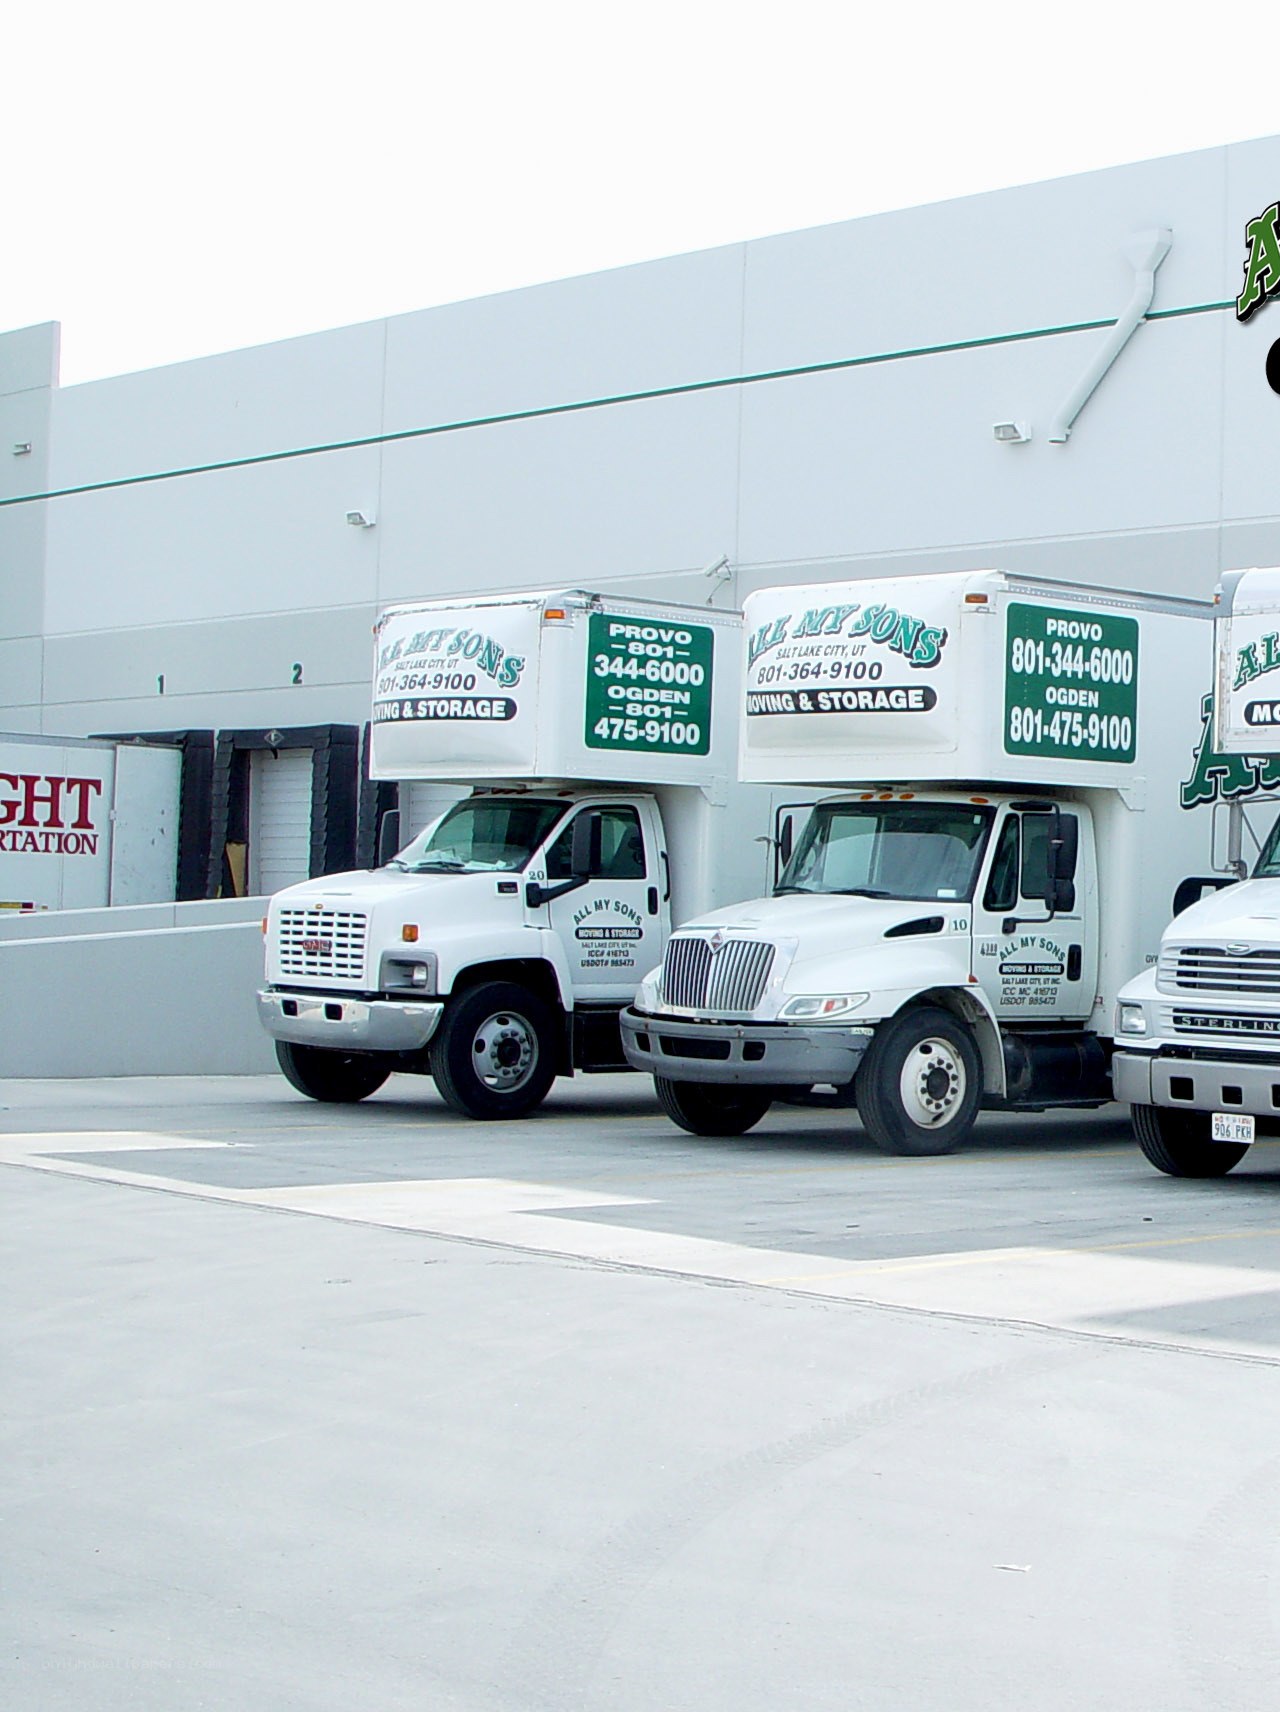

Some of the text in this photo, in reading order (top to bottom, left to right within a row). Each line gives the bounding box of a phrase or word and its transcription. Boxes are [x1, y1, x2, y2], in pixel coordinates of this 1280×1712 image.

[609, 623, 693, 645] PROVO
[792, 604, 861, 639] MY
[848, 603, 949, 669] SONS
[1046, 618, 1102, 642] PROVO
[403, 627, 457, 656] MY
[447, 627, 526, 688] SONS
[776, 644, 867, 660] SALT LAKE CITY, UT
[1012, 637, 1133, 686] 801-344-6000
[293, 663, 303, 684] 2
[411, 659, 428, 669] LAKE
[594, 654, 705, 687] 344-6000
[757, 661, 883, 685] 801-364-9100
[157, 675, 165, 694] 1
[378, 673, 476, 694] 801-364-9100
[607, 686, 691, 704] OGDEN
[799, 692, 814, 711] &
[819, 689, 925, 711] STORAGE
[1045, 686, 1099, 708] OGDEN
[402, 701, 414, 718] &
[417, 700, 507, 718] STORAGE
[594, 717, 700, 746] 475-9100
[1010, 706, 1131, 752] 801-475-9100
[0, 772, 102, 830] GHT
[529, 871, 544, 880] 20
[573, 899, 642, 925] ALL MY SONS
[953, 919, 967, 931] 10
[1000, 937, 1065, 961] ALL MY SONS
[1000, 997, 1026, 1005] USDOT
[1003, 987, 1016, 995] ICC
